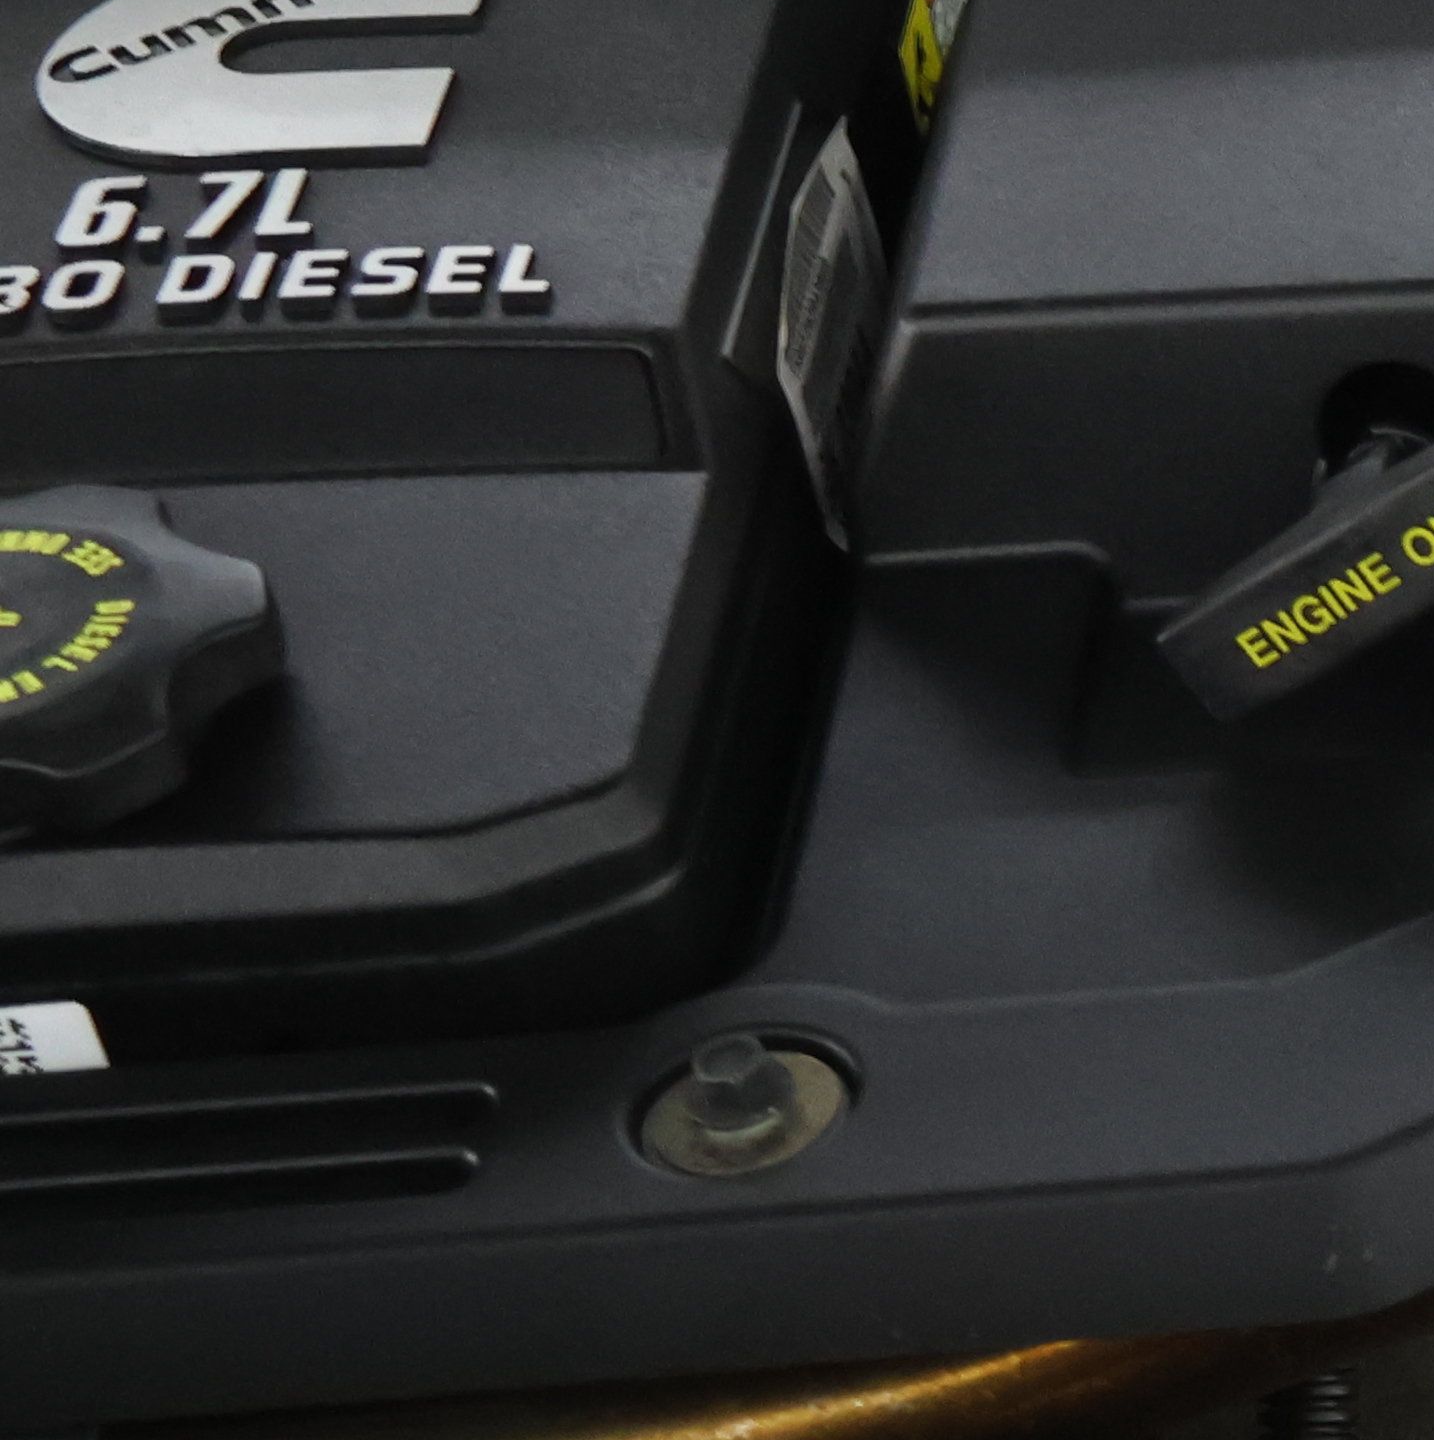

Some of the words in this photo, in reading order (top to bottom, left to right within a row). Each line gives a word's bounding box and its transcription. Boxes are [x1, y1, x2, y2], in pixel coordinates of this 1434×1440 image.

[54, 167, 314, 248] 6.7L
[155, 243, 551, 305] DIESEL
[1234, 552, 1403, 669] ENGINE
